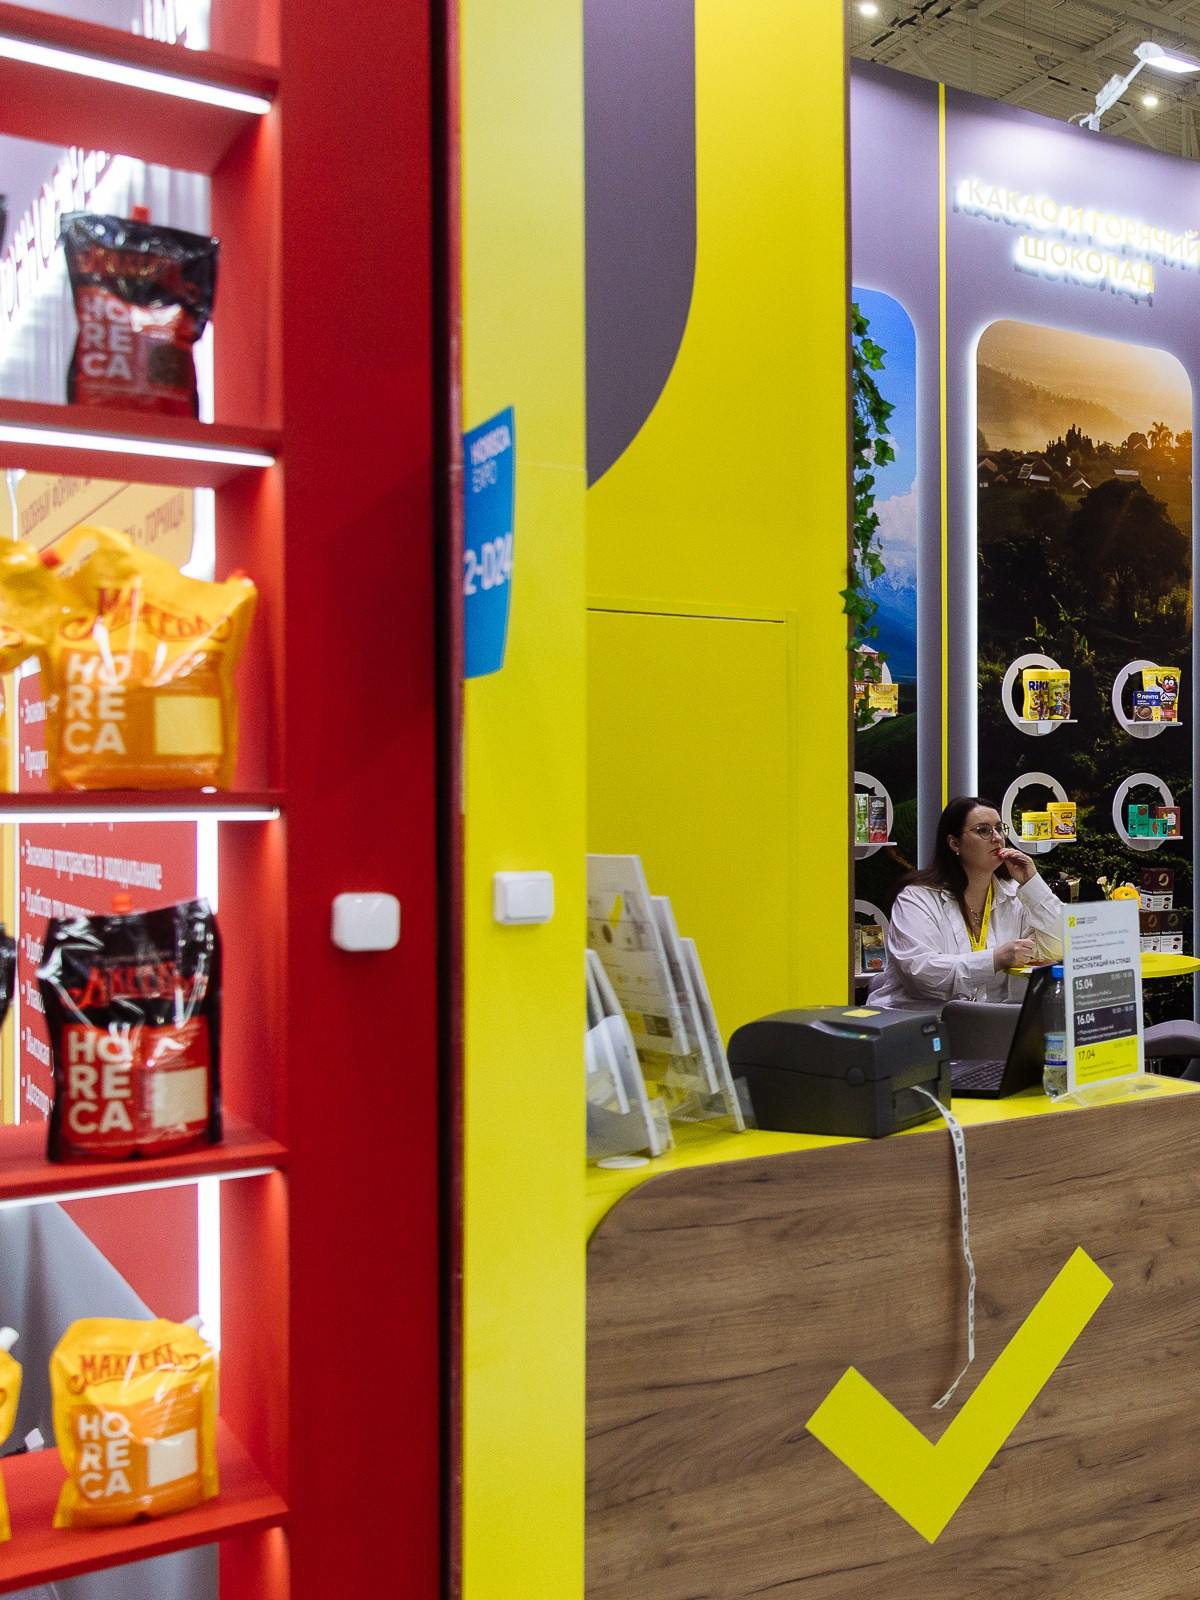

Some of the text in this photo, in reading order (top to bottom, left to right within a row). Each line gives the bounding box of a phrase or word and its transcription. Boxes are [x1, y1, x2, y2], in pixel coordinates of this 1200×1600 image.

[967, 178, 1200, 267] КАКАО И ГОРЯЧИЙ
[1023, 235, 1154, 293] ШОКОЛАД
[83, 322, 132, 352] RE
[83, 352, 132, 381] CA
[66, 652, 133, 685] HO
[65, 684, 127, 721] RE
[62, 721, 127, 756] CA
[1075, 978, 1094, 990] 15.04
[1077, 1013, 1096, 1026] 16.04
[67, 1030, 131, 1064] HO
[1078, 1049, 1096, 1061] 17.04
[68, 1062, 131, 1100] RE
[68, 1100, 134, 1134] CA
[78, 1412, 130, 1441] HO
[80, 1439, 131, 1471] RE
[79, 1469, 132, 1500] CA
